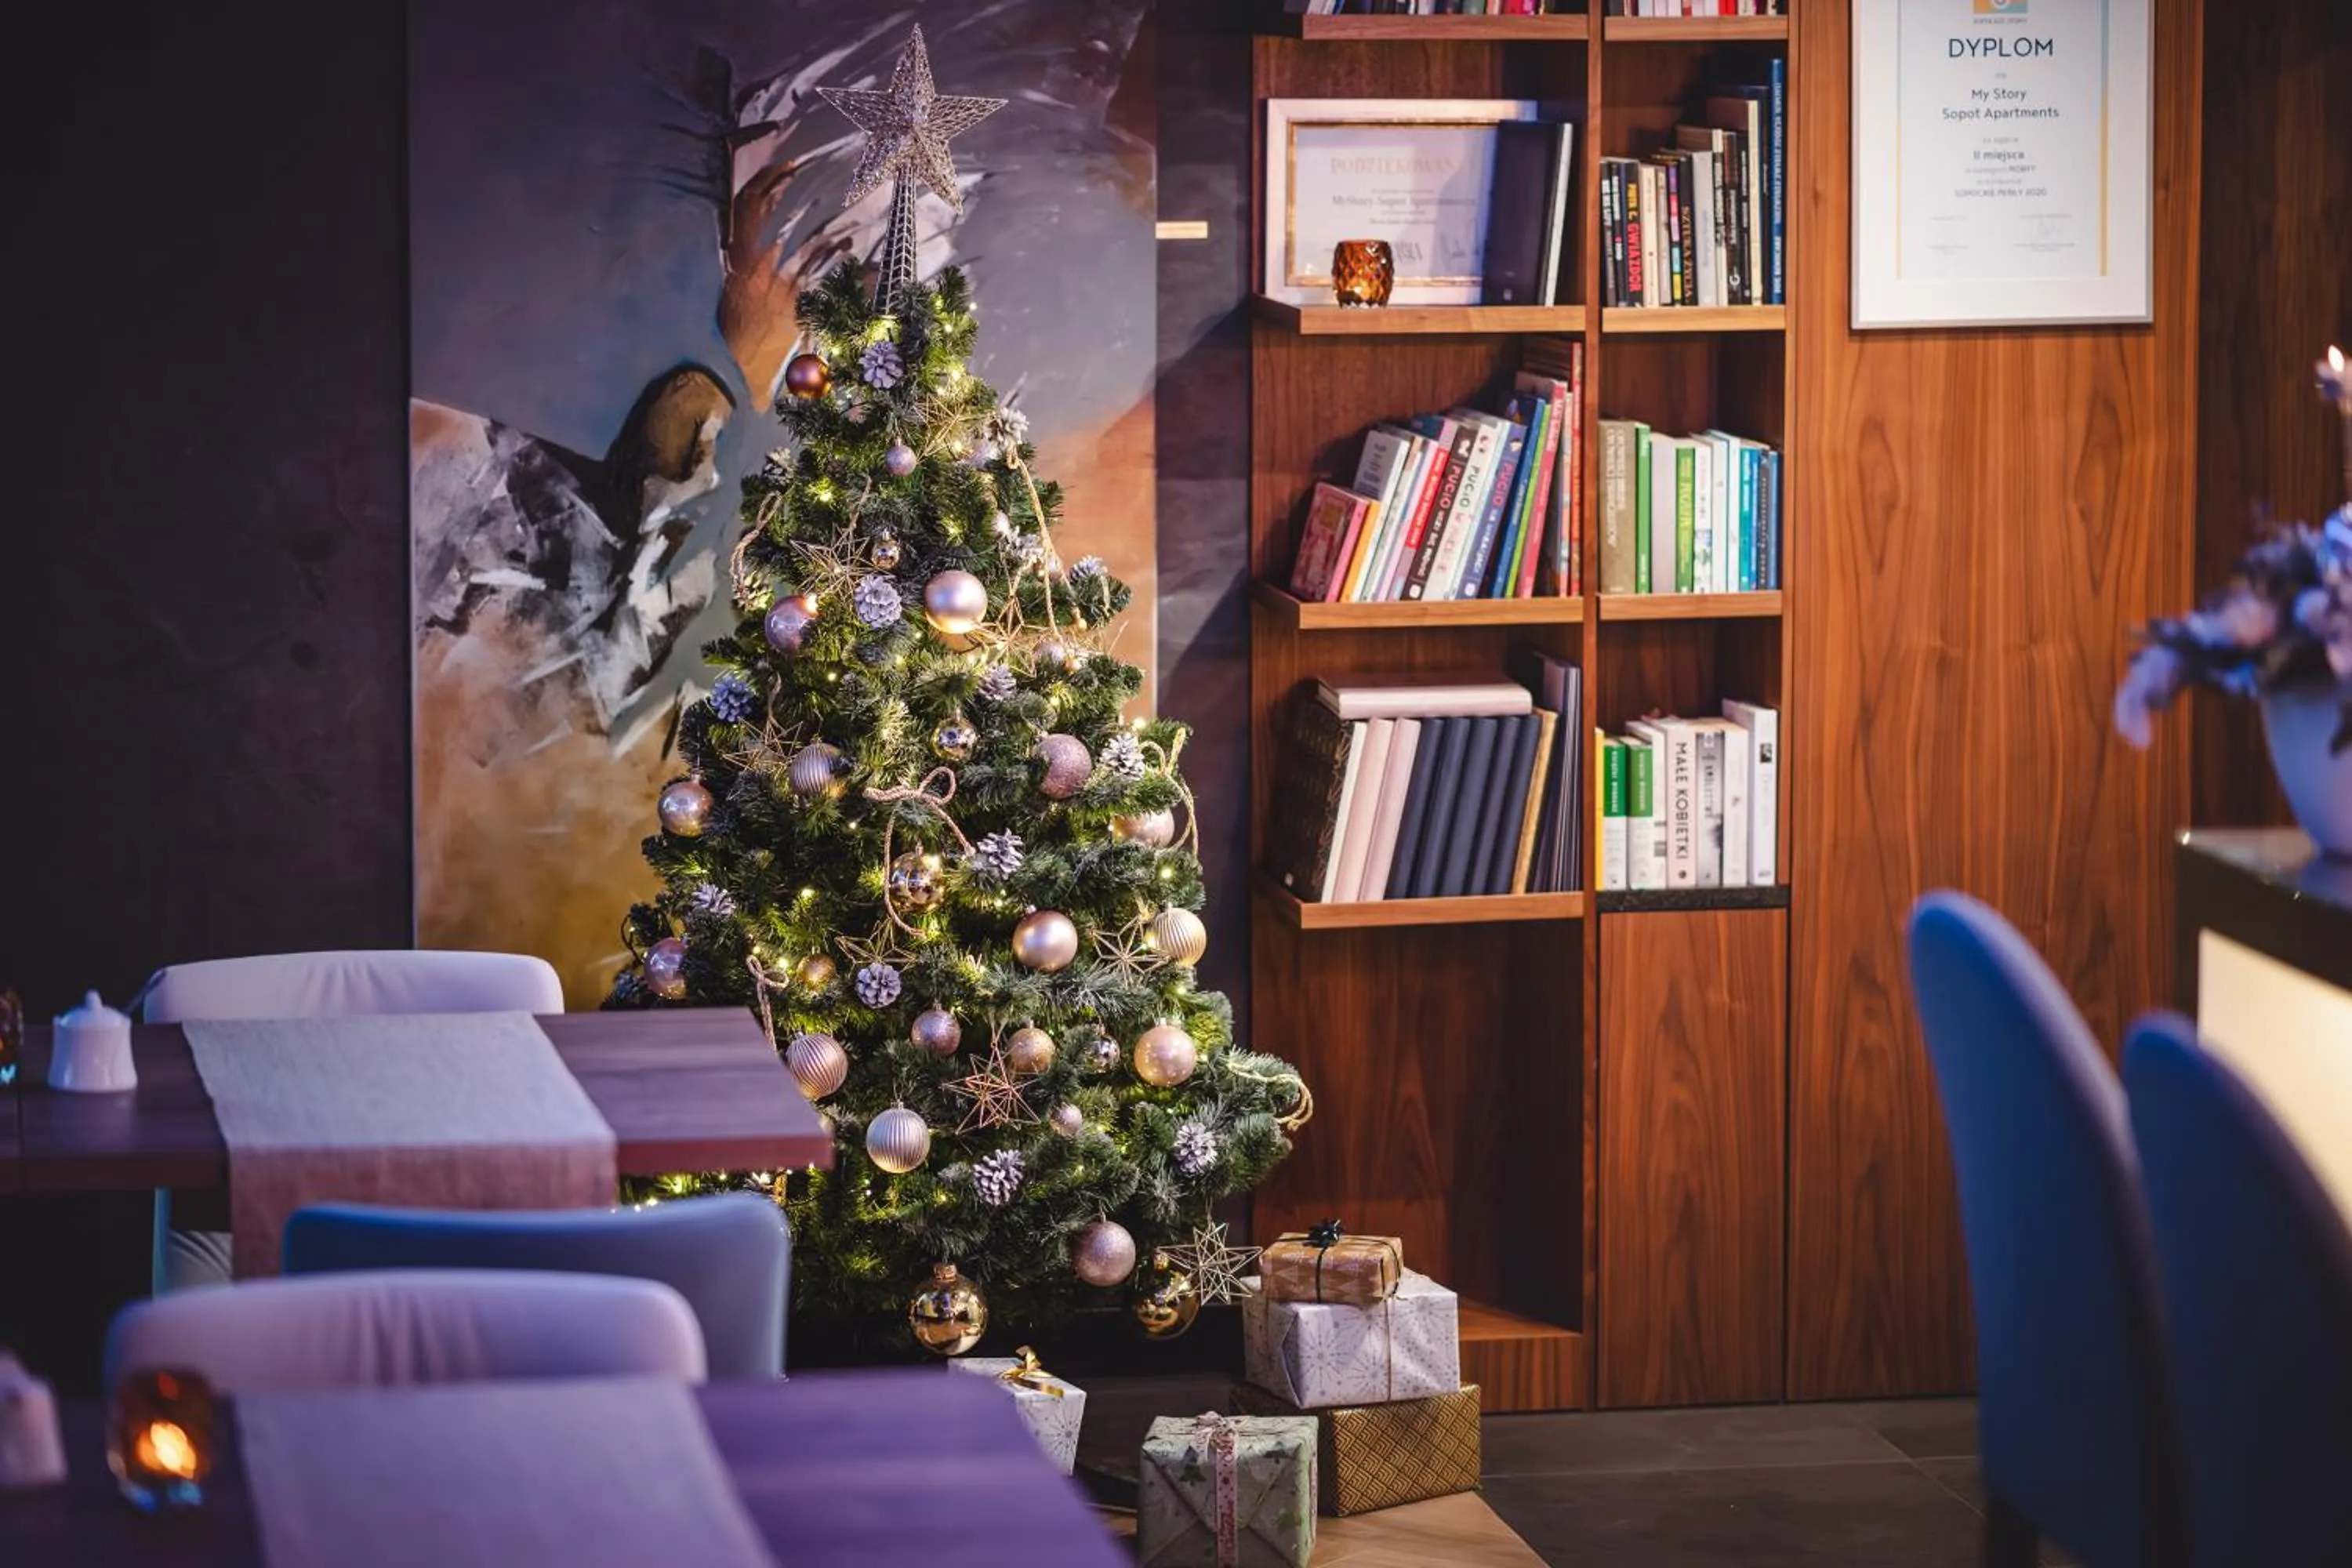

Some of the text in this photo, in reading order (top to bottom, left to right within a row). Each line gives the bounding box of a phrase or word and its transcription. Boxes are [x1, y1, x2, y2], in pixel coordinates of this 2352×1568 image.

[1948, 37, 2053, 58] DYPLOM
[1942, 107, 2060, 122] Sopot Apartments
[1971, 87, 2027, 102] My Story
[1983, 150, 2025, 162] miejsca
[1628, 223, 1642, 292] GWIAZDOR
[1439, 464, 1462, 510] PUCIO
[1459, 464, 1481, 509] PUCIO
[1492, 461, 1515, 507] PUCIO
[1675, 742, 1689, 859] MAŁE KOBIETKI
